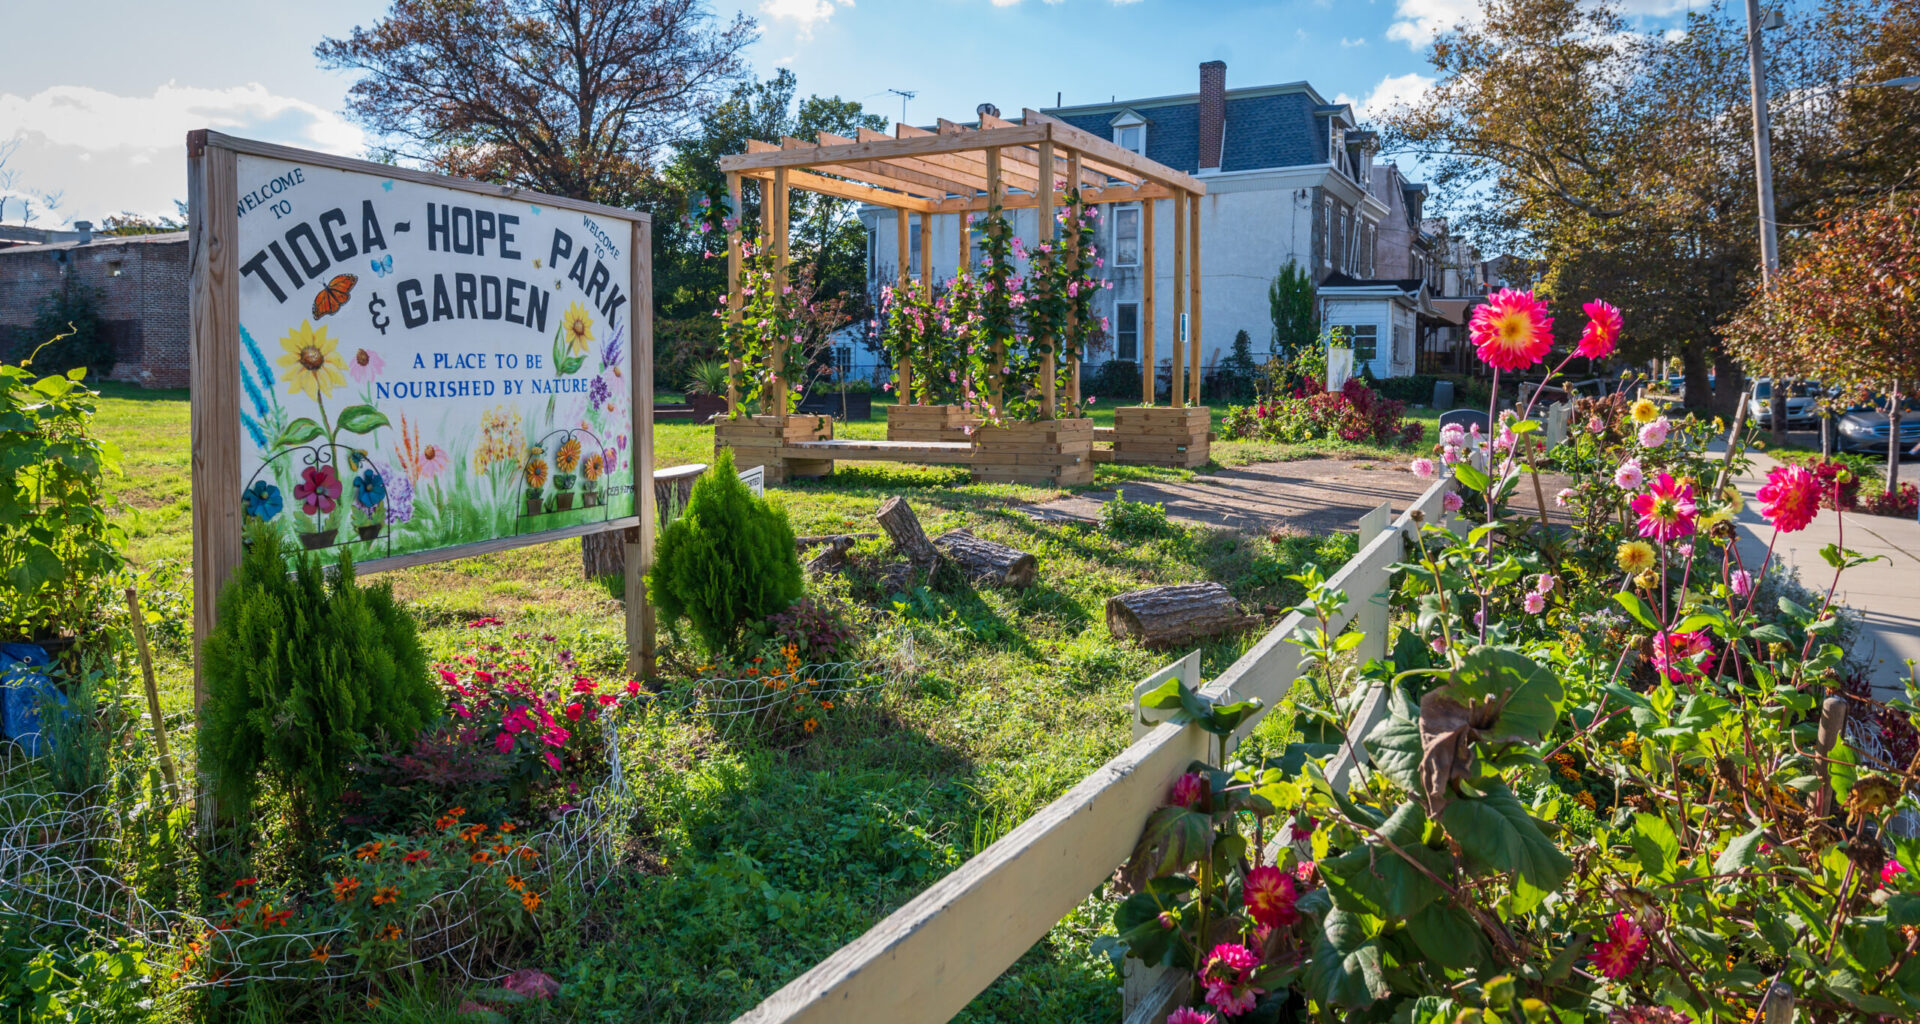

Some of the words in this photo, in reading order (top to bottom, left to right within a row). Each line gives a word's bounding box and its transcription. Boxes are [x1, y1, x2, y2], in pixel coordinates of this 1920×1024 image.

[236, 167, 305, 218] WELCOME
[270, 199, 292, 219] TO
[583, 215, 620, 260] WELCOME
[594, 243, 605, 260] TO
[239, 199, 387, 304] TIOGA
[427, 202, 522, 260] HOPE
[549, 227, 627, 331] PARK
[368, 291, 390, 335] &
[397, 272, 550, 333] GARDEN
[413, 352, 426, 369] A
[433, 352, 487, 369] PLACE
[495, 353, 518, 369] TO
[526, 354, 543, 369] BE
[376, 379, 495, 399] NOURISHED
[504, 379, 524, 395] BY
[531, 378, 588, 394] NATURE
